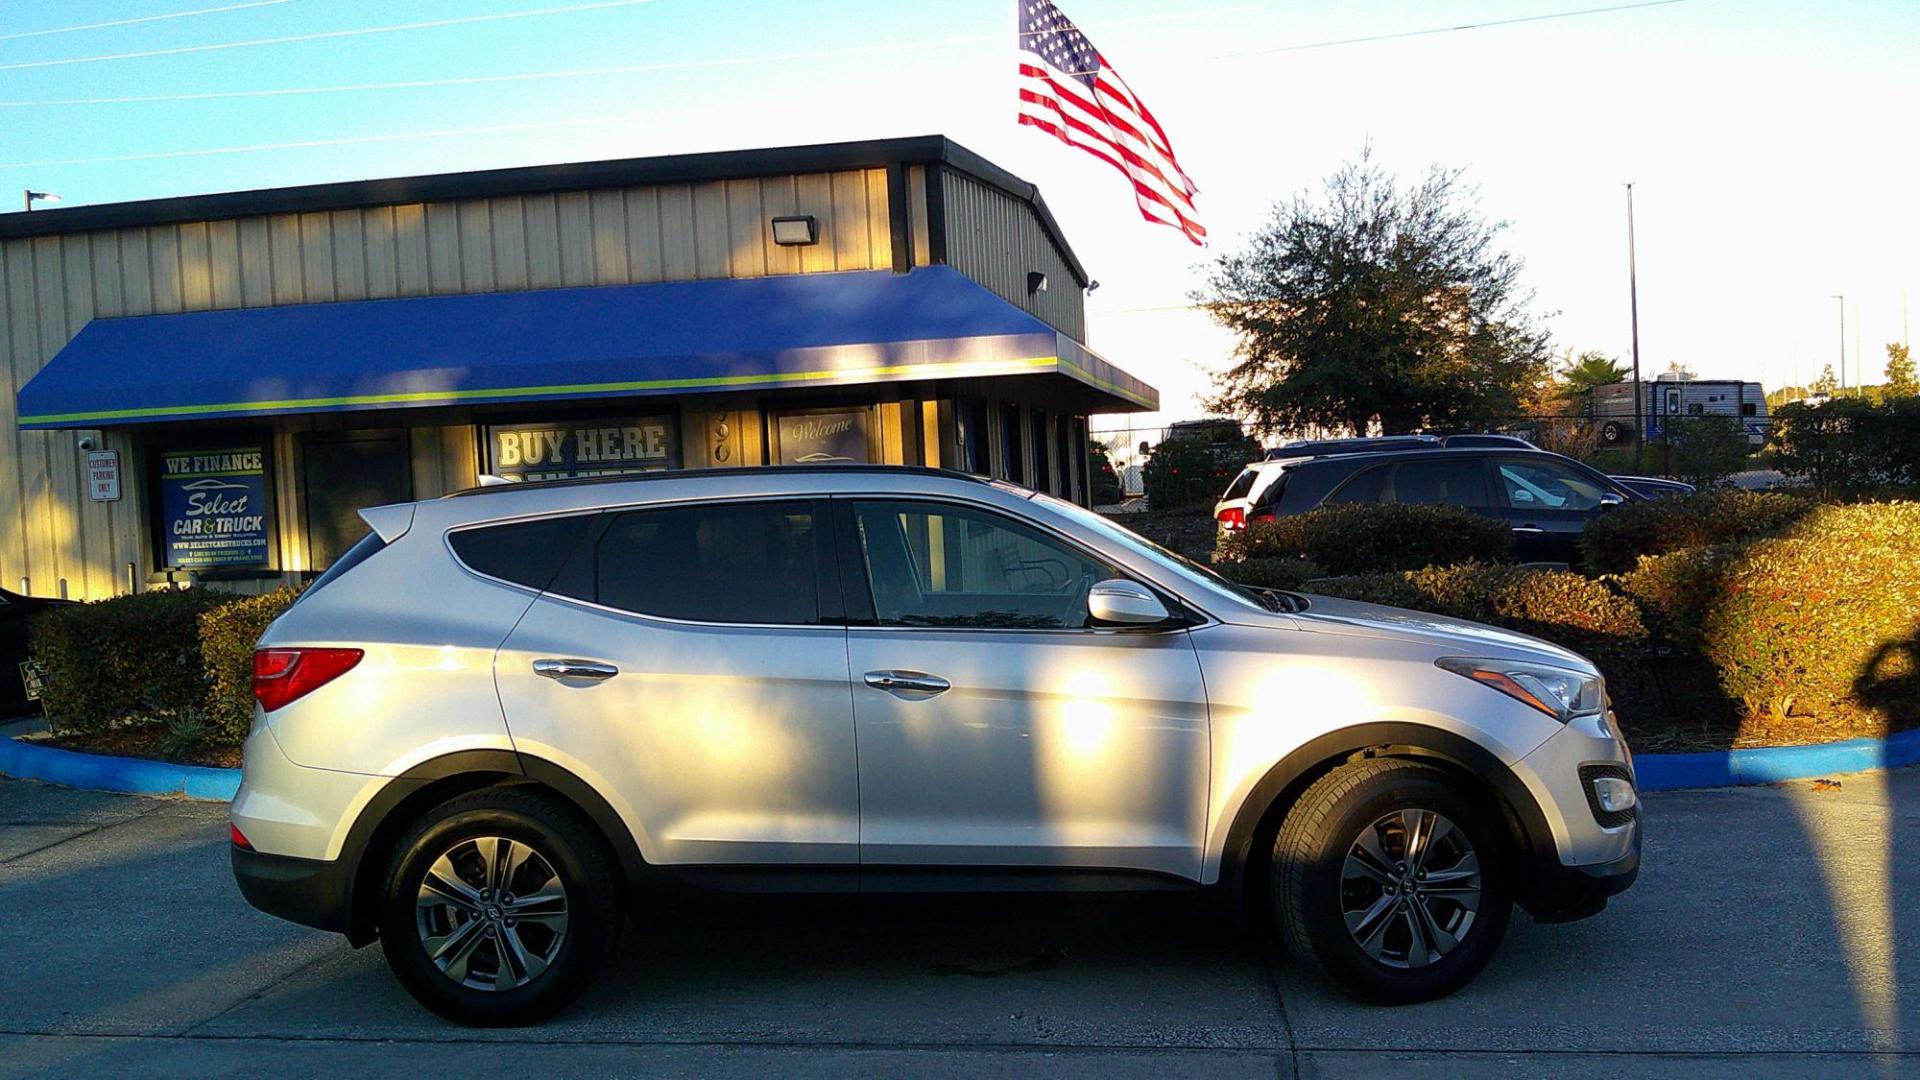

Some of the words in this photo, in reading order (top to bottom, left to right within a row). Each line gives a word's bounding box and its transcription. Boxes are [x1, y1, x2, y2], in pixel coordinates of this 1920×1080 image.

[792, 419, 852, 441] Welcome
[498, 430, 567, 467] BUY
[575, 425, 666, 462] HERE
[89, 459, 117, 468] CUSTOMER
[166, 456, 190, 474] WE
[194, 453, 262, 472] FINANCE
[93, 470, 115, 480] PARKING
[98, 483, 110, 493] ONLY
[185, 492, 248, 516] Select
[173, 519, 202, 534] CAR
[203, 518, 215, 534] &
[216, 516, 263, 533] TRUCK
